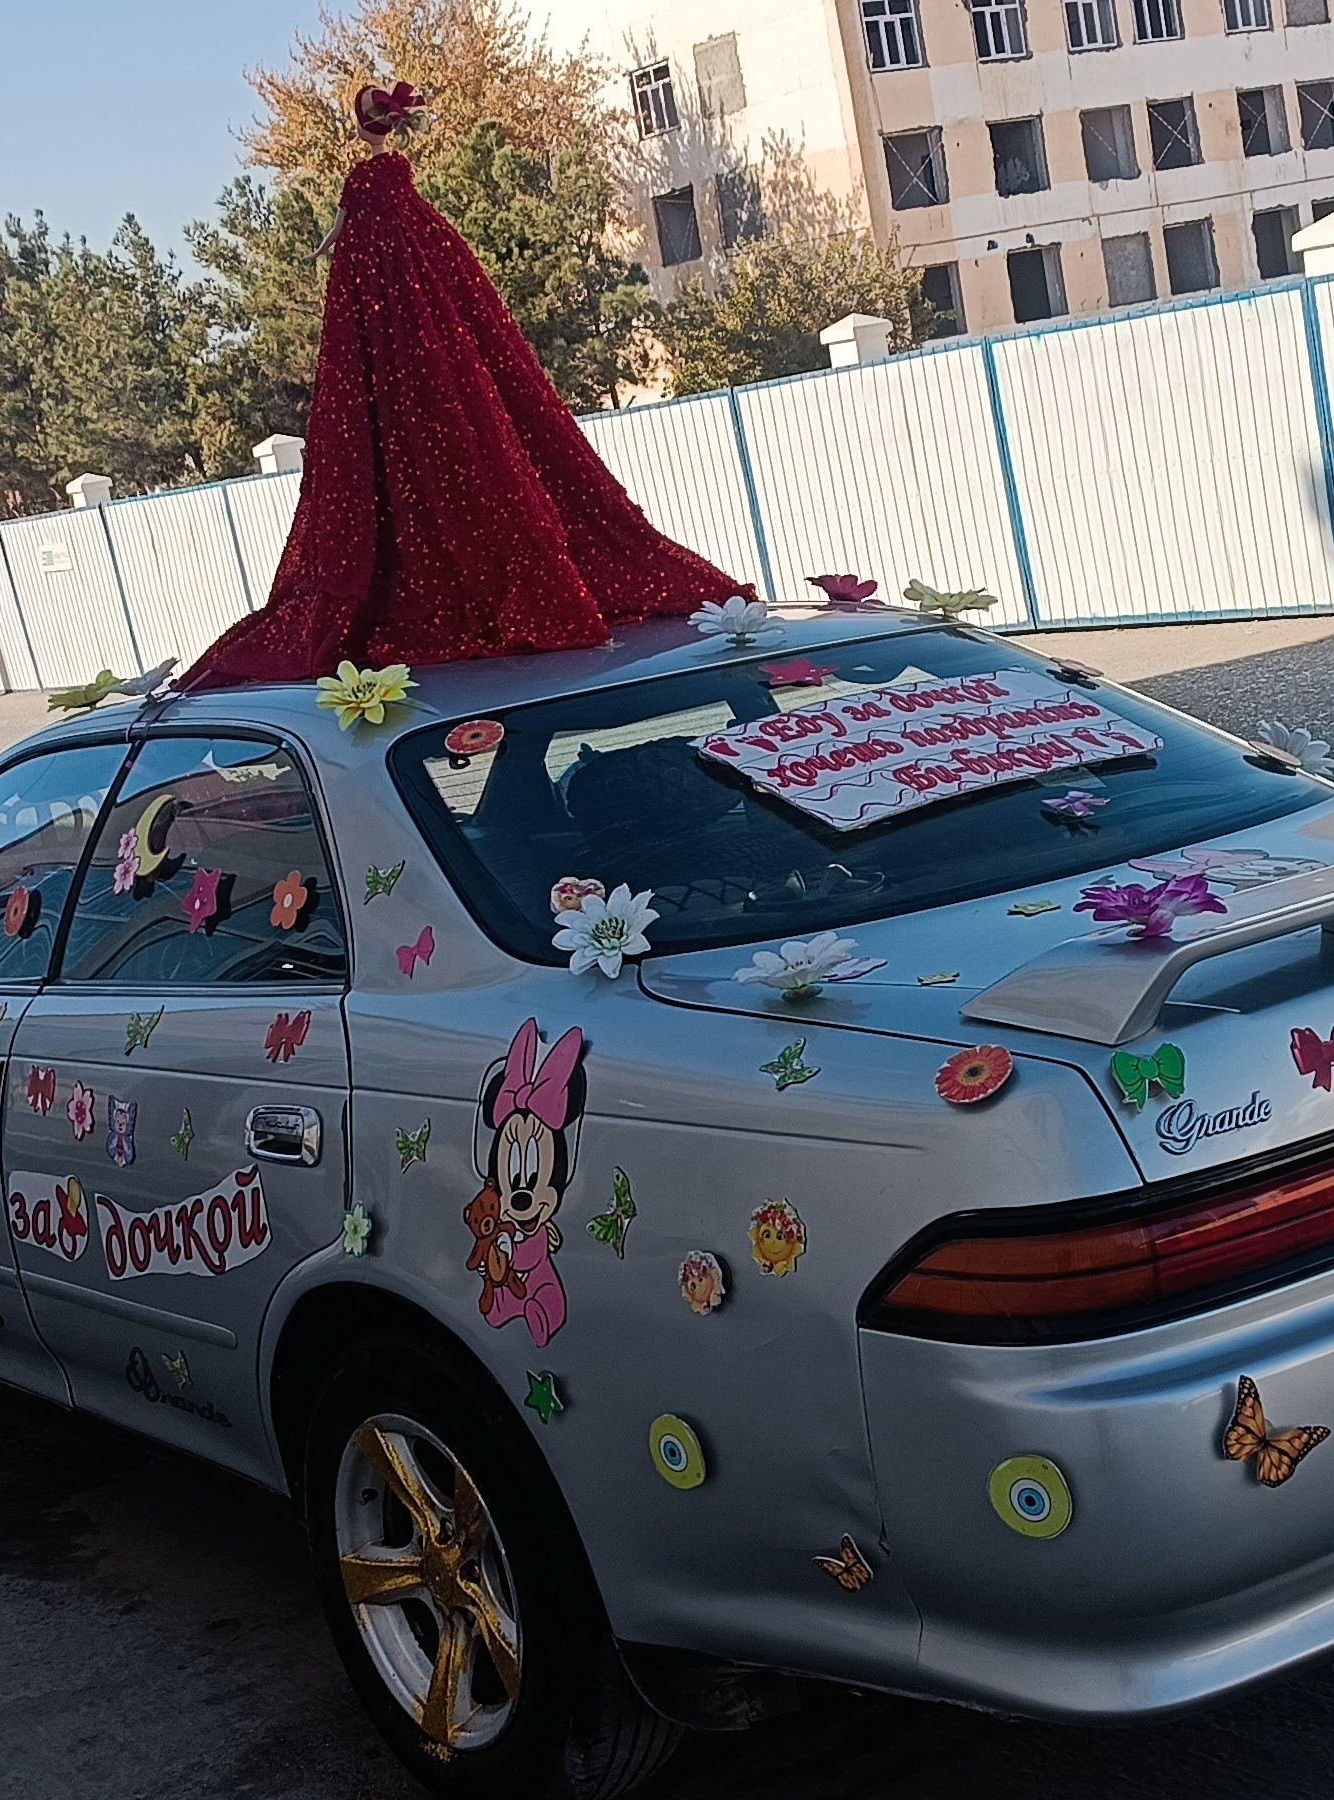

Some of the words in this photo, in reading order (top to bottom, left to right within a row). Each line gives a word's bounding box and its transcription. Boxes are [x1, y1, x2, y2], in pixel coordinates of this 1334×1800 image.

[759, 711, 847, 742] Еду
[842, 701, 891, 721] за
[876, 678, 1010, 712] дочкой
[901, 701, 1101, 747] поздравить
[1155, 1090, 1273, 1155] Grande
[9, 1191, 58, 1248] за
[97, 1163, 267, 1277] дочкой
